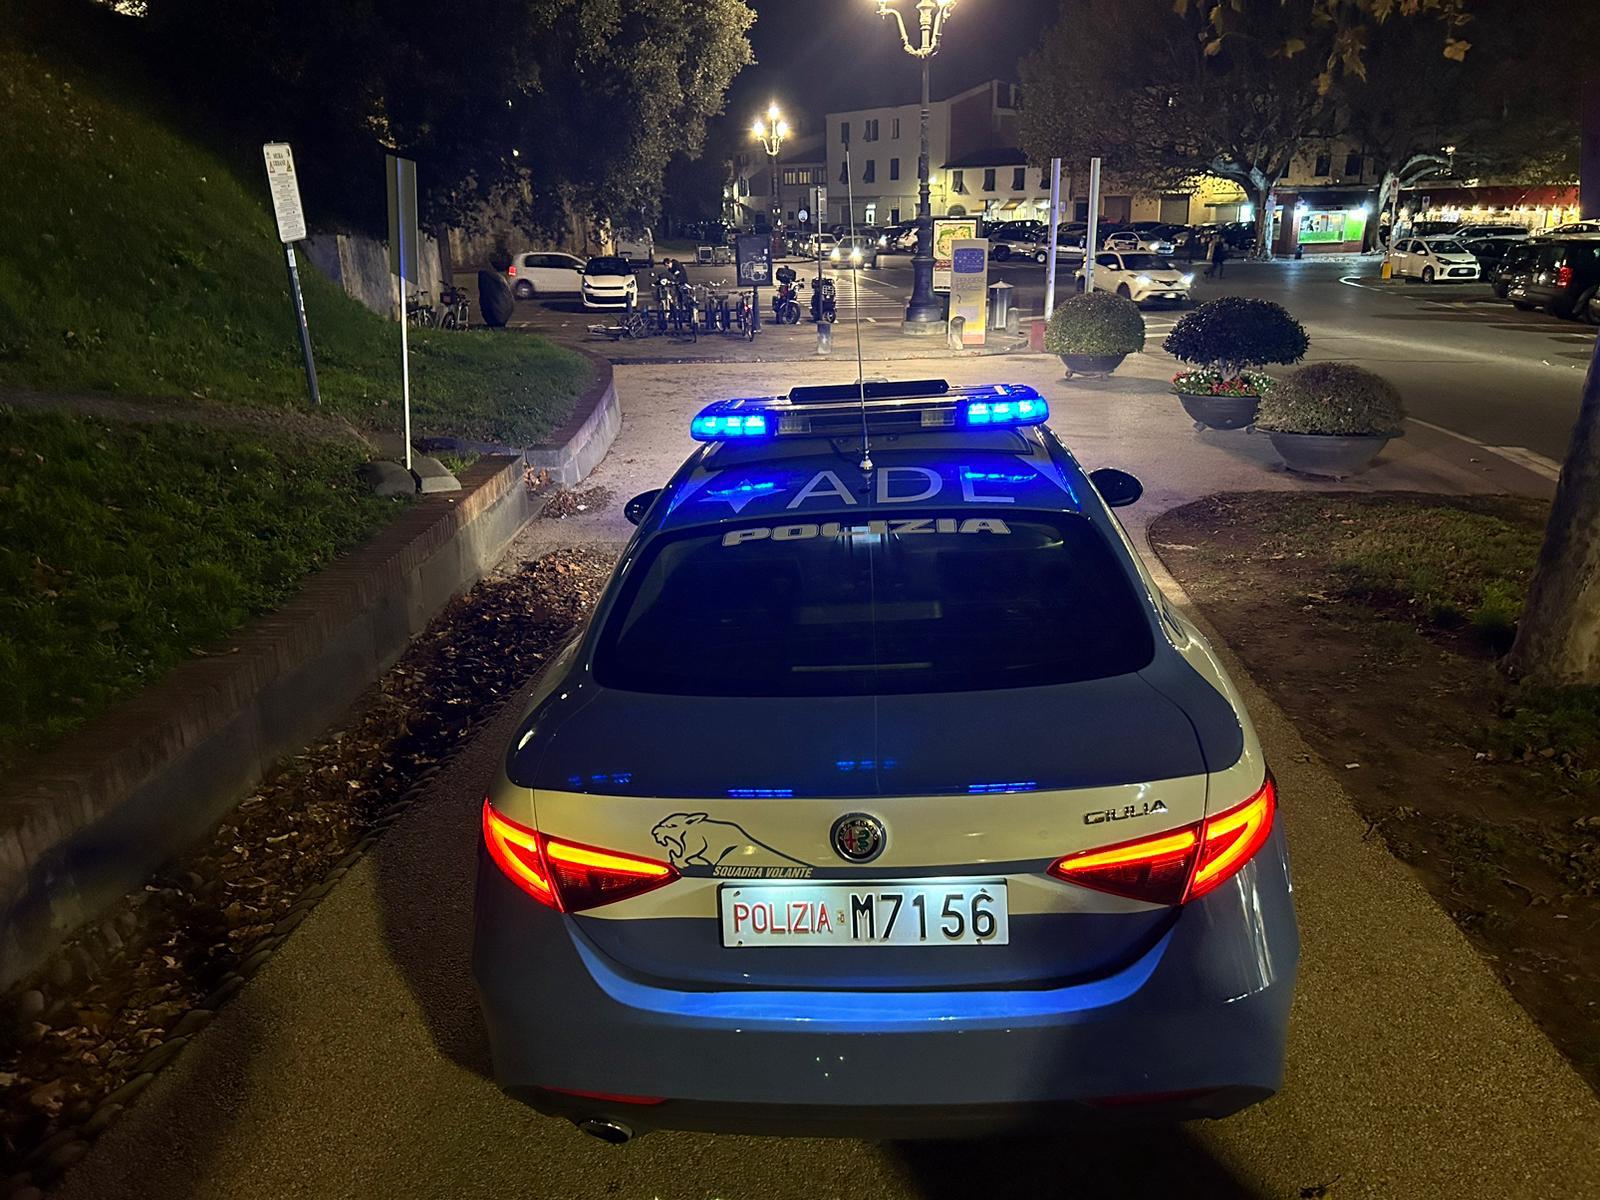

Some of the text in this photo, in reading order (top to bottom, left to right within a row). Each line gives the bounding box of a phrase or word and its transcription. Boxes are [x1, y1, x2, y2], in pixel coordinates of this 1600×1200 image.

[722, 518, 1012, 547] POLIZIA
[1083, 799, 1168, 825] GIULIA
[712, 866, 813, 878] SQUADRA VOLANTE
[733, 893, 997, 941] POLIZIA M7156
